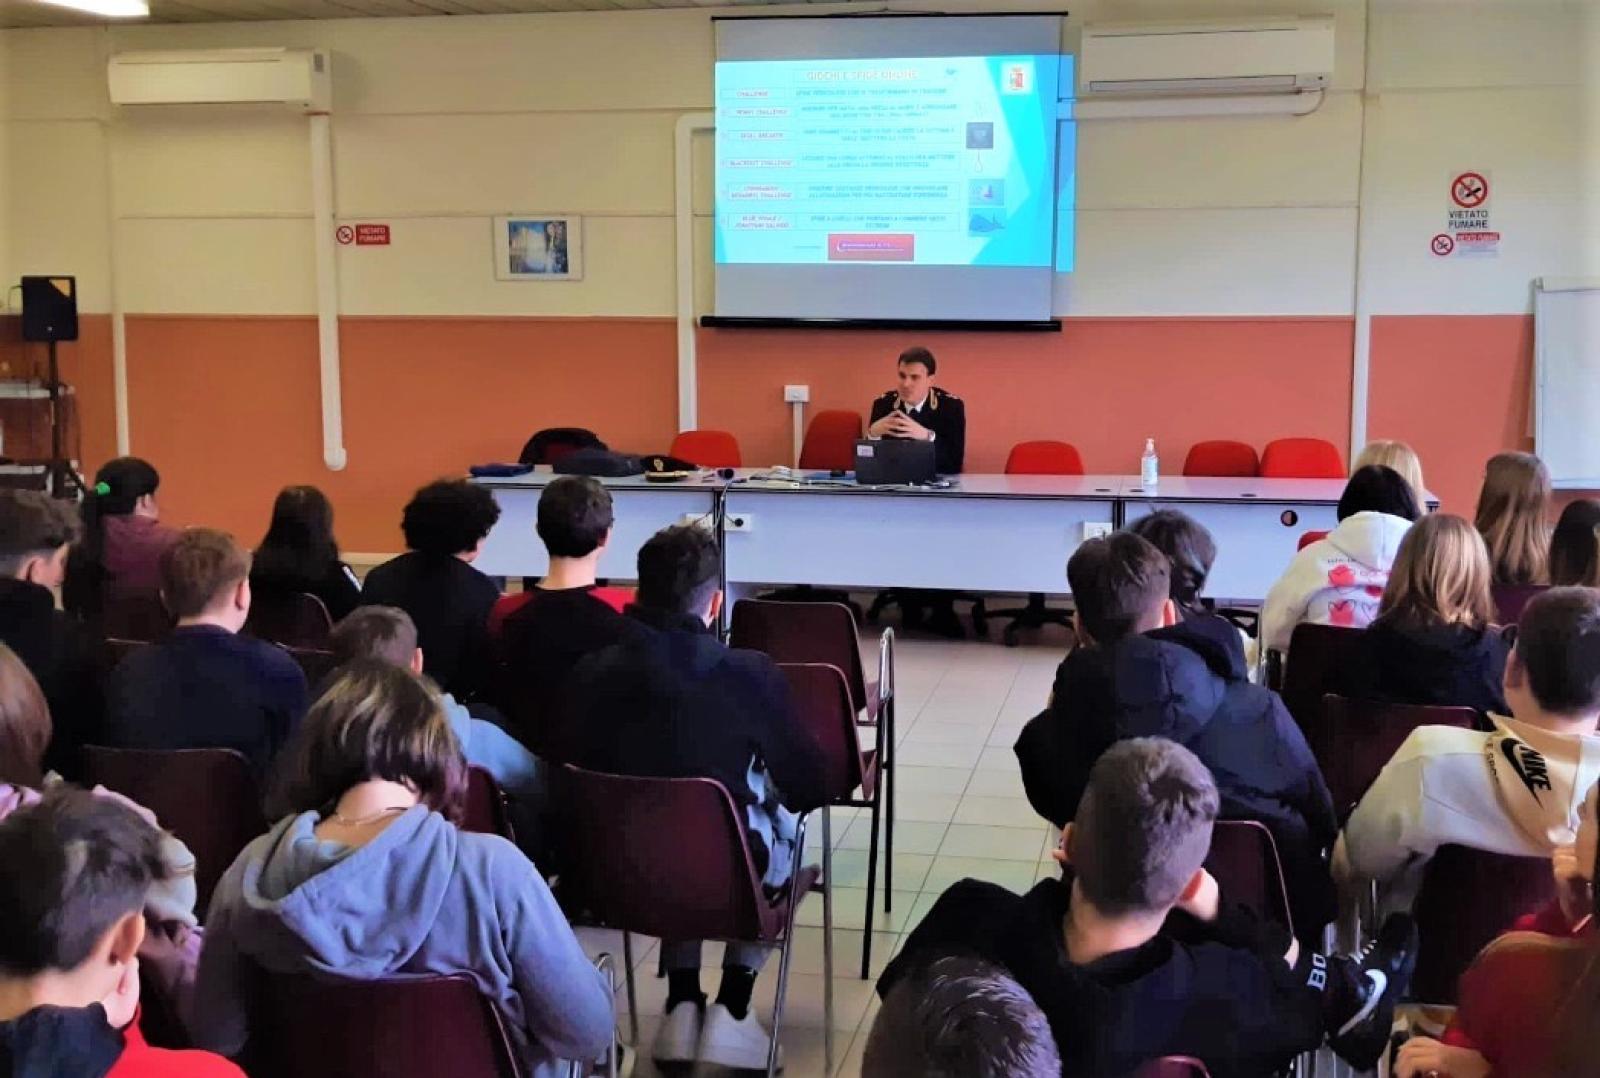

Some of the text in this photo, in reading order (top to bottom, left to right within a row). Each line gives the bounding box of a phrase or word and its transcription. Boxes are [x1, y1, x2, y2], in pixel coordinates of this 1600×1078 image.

[1448, 210, 1488, 219] VIETATO
[1448, 219, 1488, 229] FUMARE
[1518, 745, 1552, 791] NIKE
